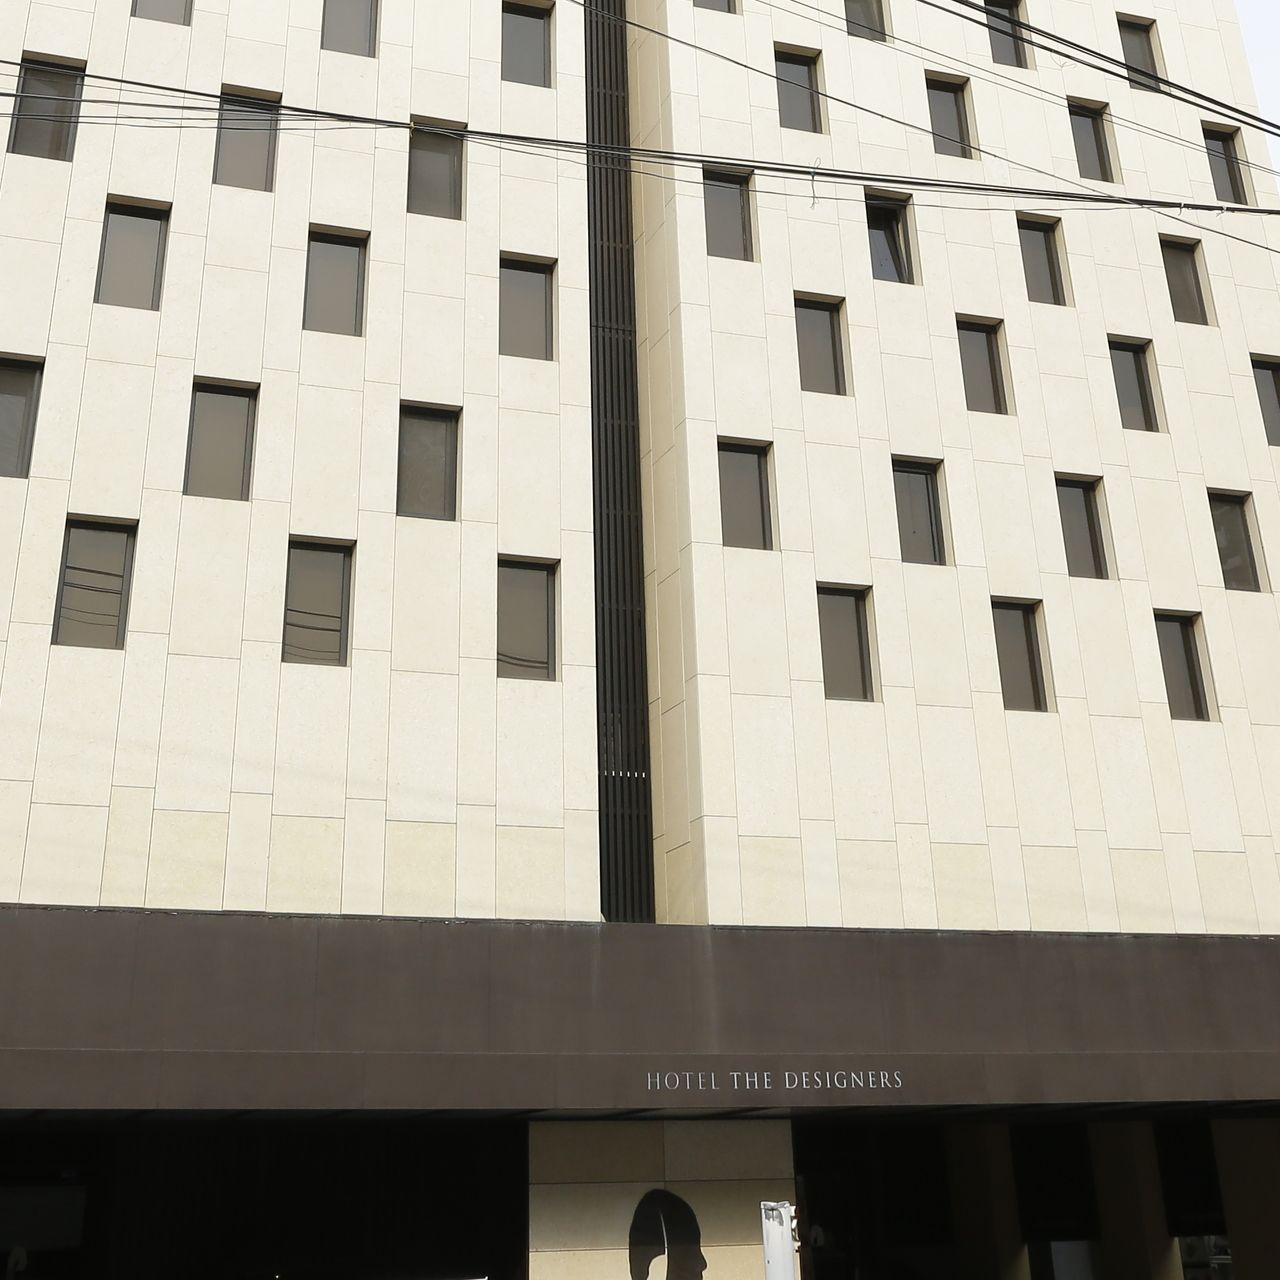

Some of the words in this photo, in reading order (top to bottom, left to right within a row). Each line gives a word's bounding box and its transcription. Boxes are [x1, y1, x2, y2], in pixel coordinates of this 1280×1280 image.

[646, 1071, 720, 1090] HOTEL
[729, 1071, 772, 1090] THE
[784, 1070, 904, 1089] DESIGNERS
